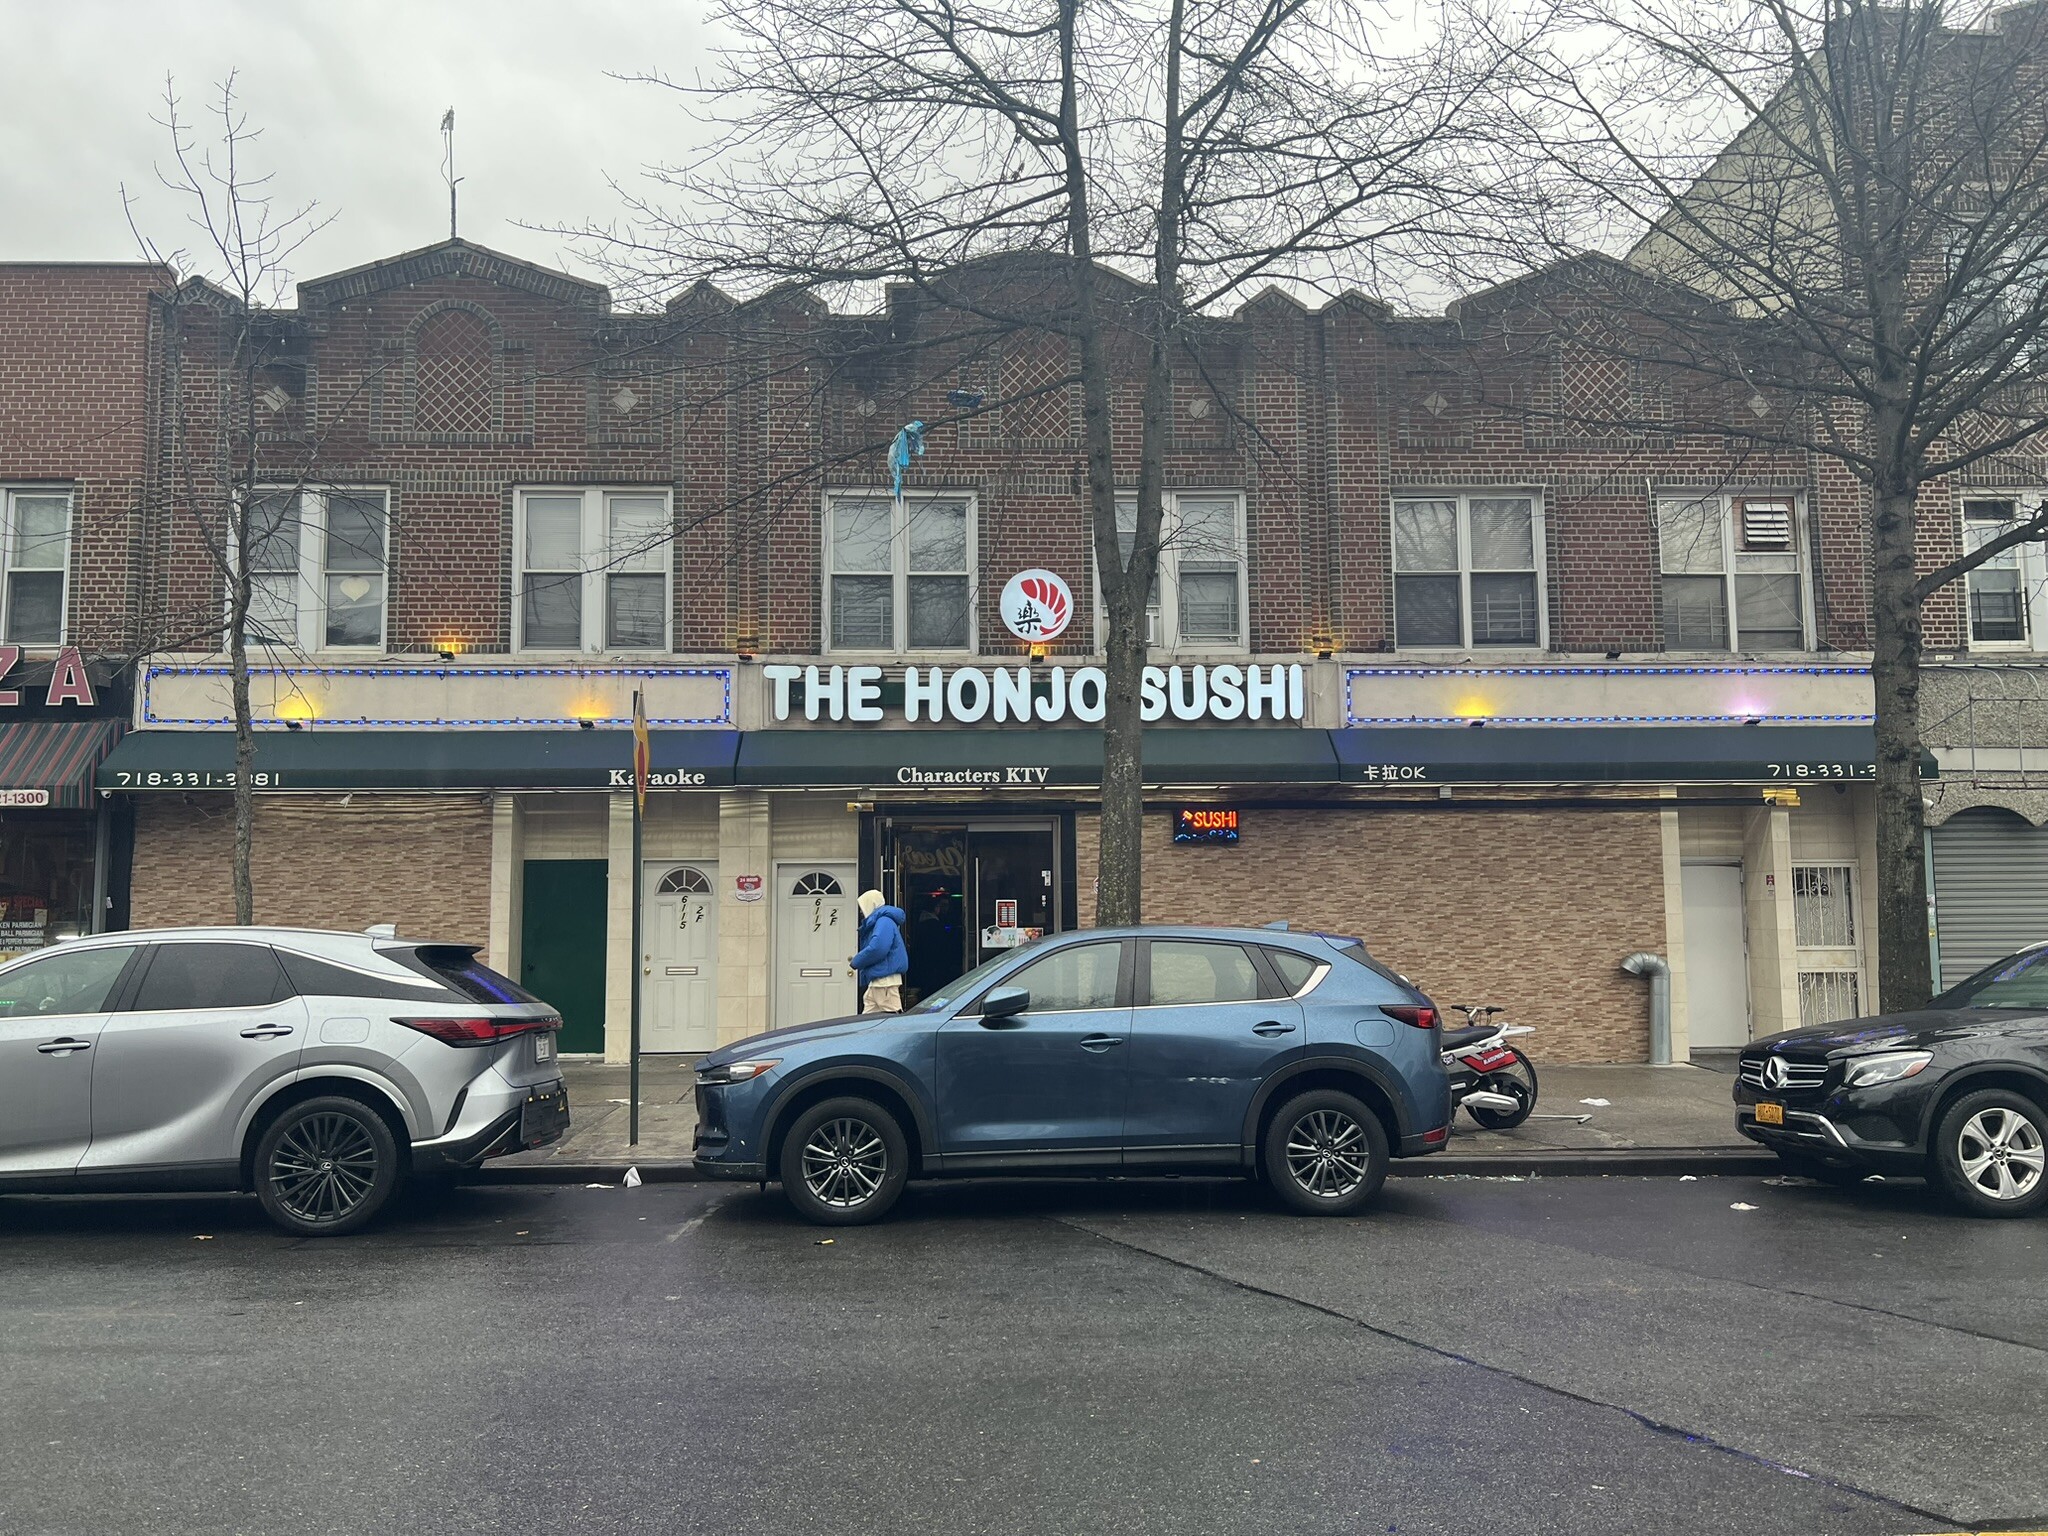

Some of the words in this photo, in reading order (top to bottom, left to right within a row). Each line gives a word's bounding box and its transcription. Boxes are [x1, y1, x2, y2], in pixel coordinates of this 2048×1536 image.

[763, 665, 884, 723] THE
[904, 665, 1107, 723] HONJO
[1140, 663, 1304, 722] SUSHI
[116, 772, 280, 786] 718-331-381
[608, 768, 706, 786] Kaoke
[897, 766, 1000, 783] Characters
[1005, 766, 1050, 783] KTV
[1363, 764, 1426, 781] 卡拉OK
[1767, 764, 1922, 777] 718-331-3
[1192, 810, 1238, 828] SUSHI
[679, 895, 689, 930] 6115
[813, 898, 822, 932] 6117
